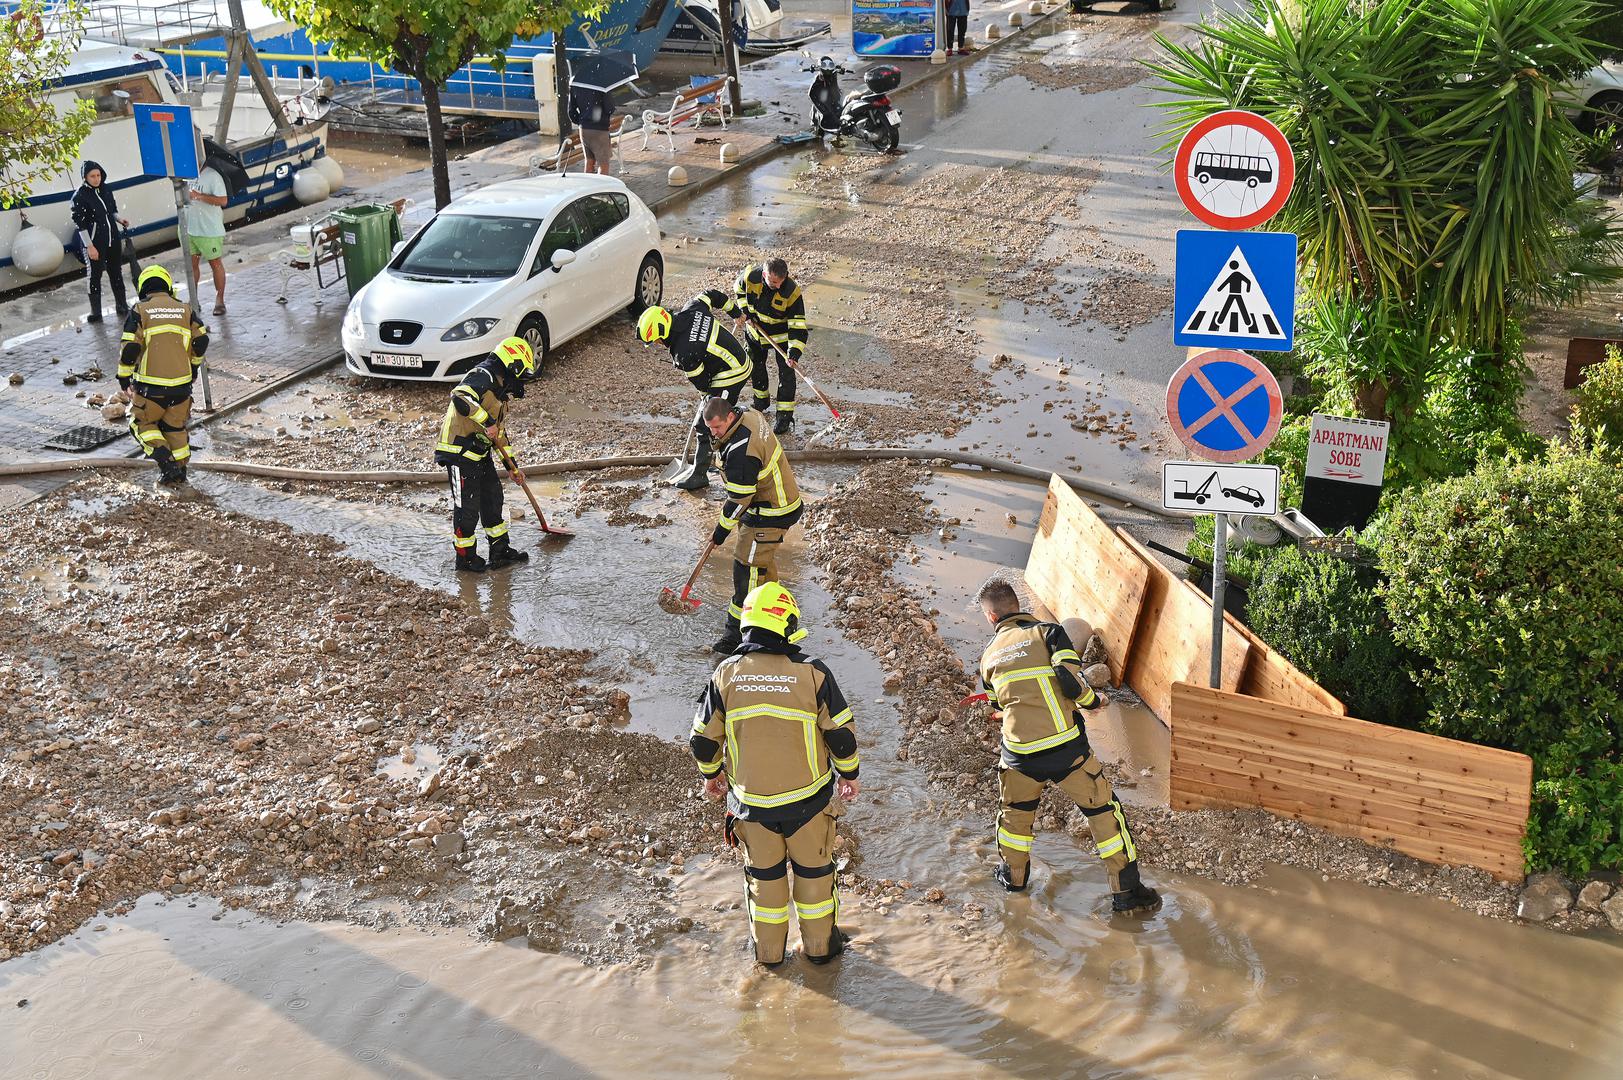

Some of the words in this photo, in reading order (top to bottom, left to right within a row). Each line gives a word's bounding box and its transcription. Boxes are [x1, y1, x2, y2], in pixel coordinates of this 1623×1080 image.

[594, 23, 628, 42] DAVID
[1313, 429, 1383, 451] APARTMANI
[1329, 449, 1361, 468] SOBE
[730, 674, 797, 684] VATROGASCI
[736, 684, 791, 693] PODGORA
